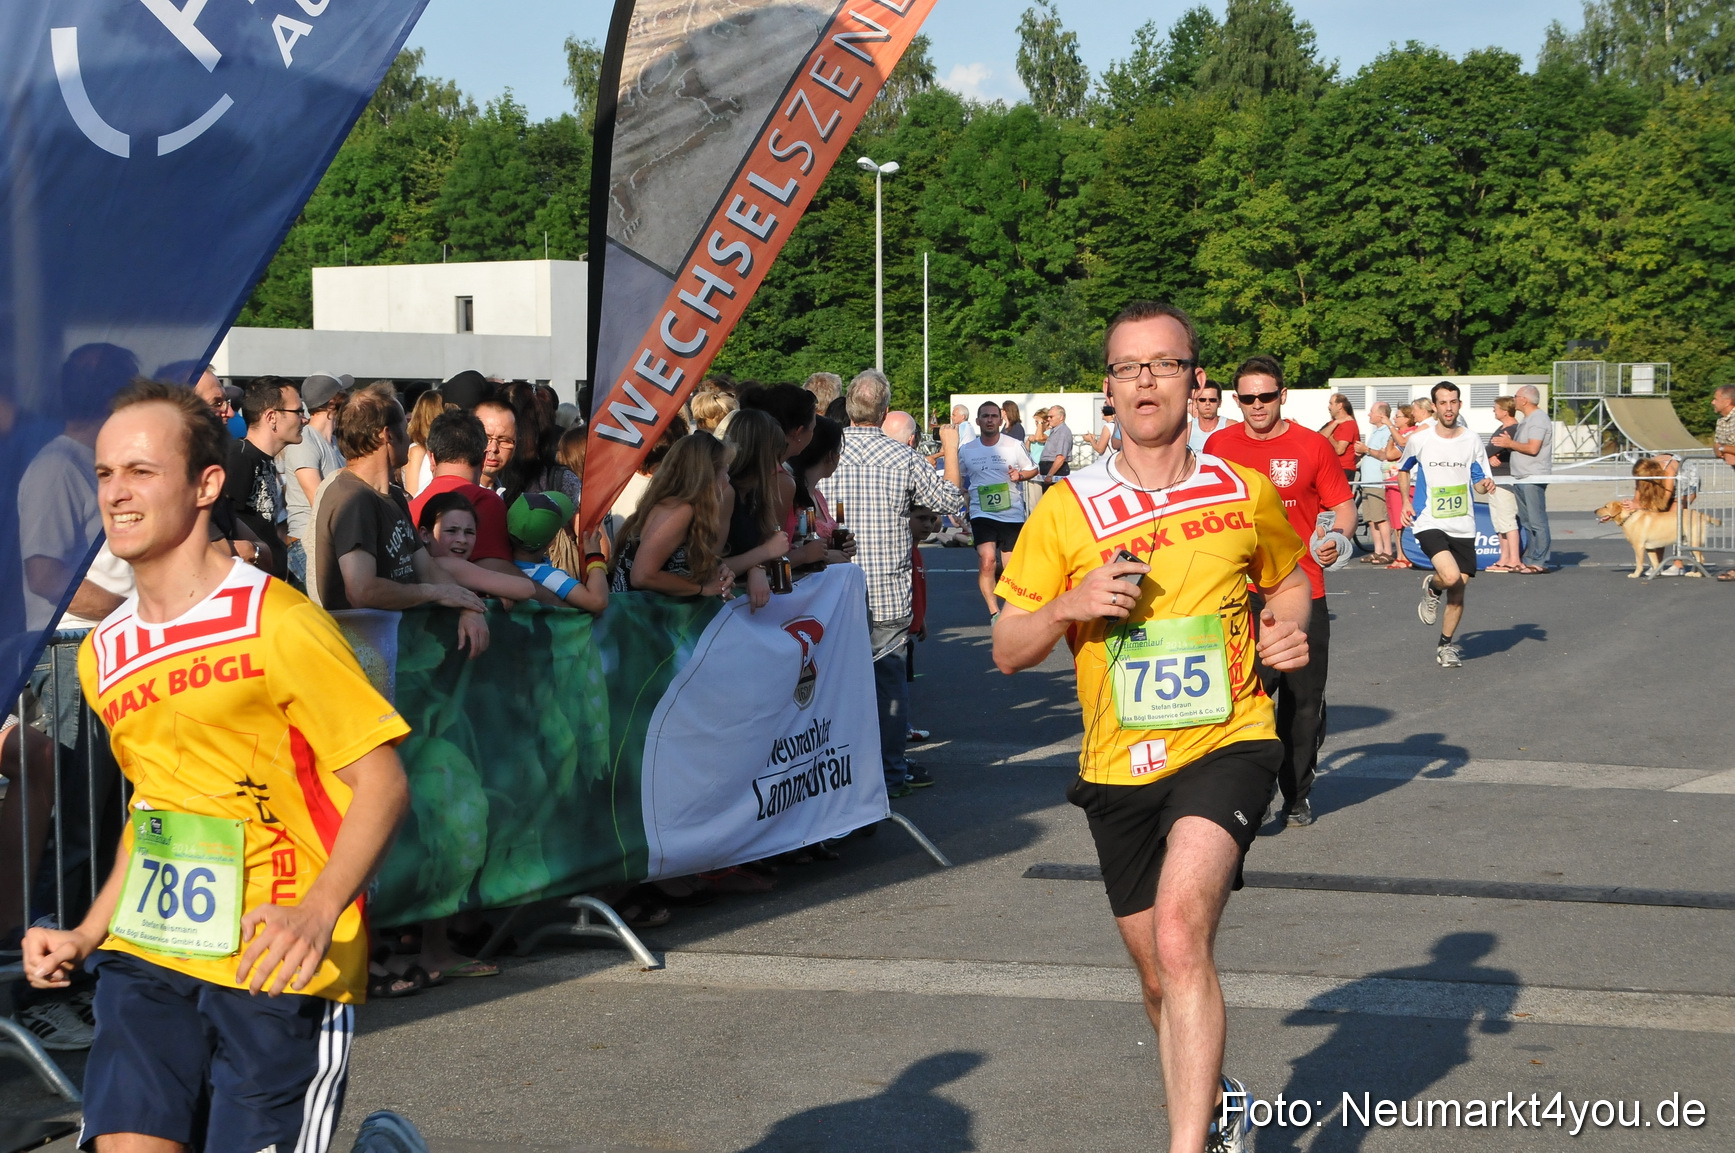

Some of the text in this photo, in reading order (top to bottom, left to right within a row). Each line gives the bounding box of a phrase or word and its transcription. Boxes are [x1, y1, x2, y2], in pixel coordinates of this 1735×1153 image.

[986, 493, 1001, 505] 29
[1437, 496, 1462, 511] 219
[1181, 511, 1253, 541] BÖGL
[102, 653, 265, 731] MAX BÖGL
[1125, 655, 1210, 702] 755
[1134, 714, 1146, 722] Bögl
[1147, 712, 1178, 720] Bauservice
[767, 718, 831, 767] Neumarkter
[136, 859, 216, 923] 786
[114, 926, 126, 935] Max
[126, 928, 139, 938] Bögl
[140, 931, 169, 943] Bauservice
[171, 937, 193, 946] GmbH
[203, 940, 215, 948] Co.
